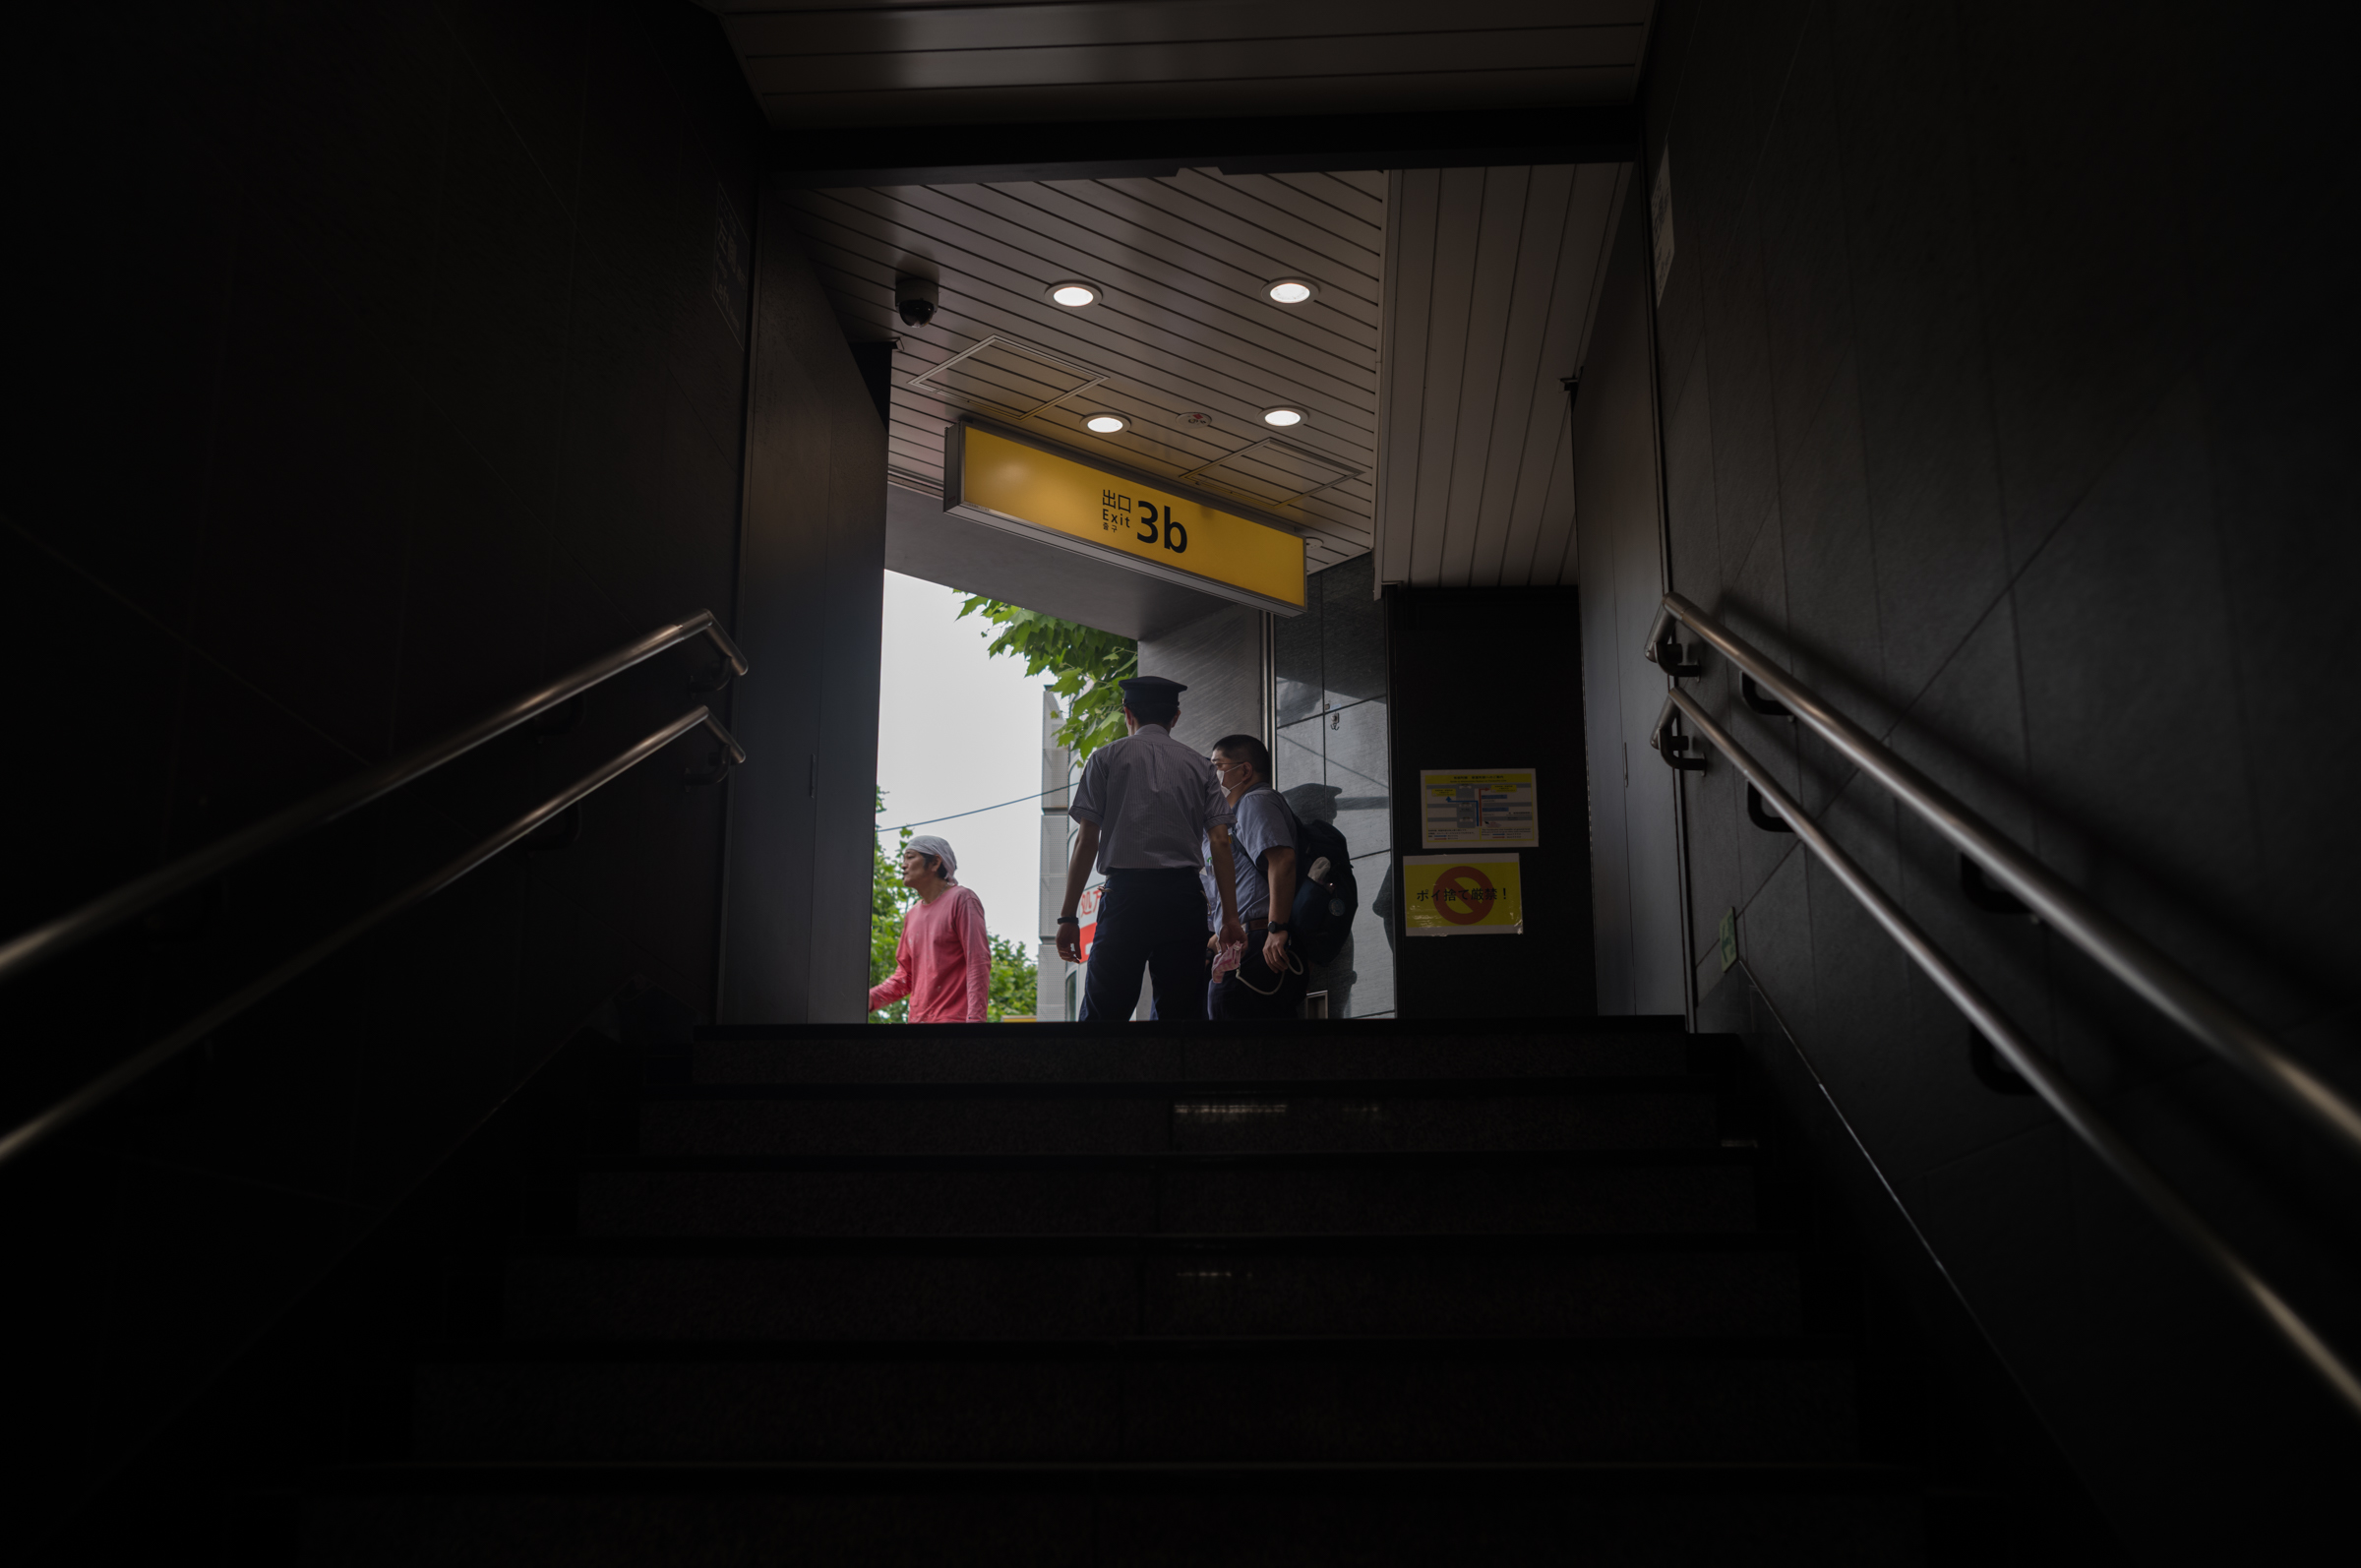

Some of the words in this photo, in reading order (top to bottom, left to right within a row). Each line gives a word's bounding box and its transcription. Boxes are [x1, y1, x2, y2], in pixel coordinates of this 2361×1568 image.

[1102, 489, 1131, 513] 出口
[1102, 508, 1130, 528] Exit
[1137, 501, 1187, 554] 3b
